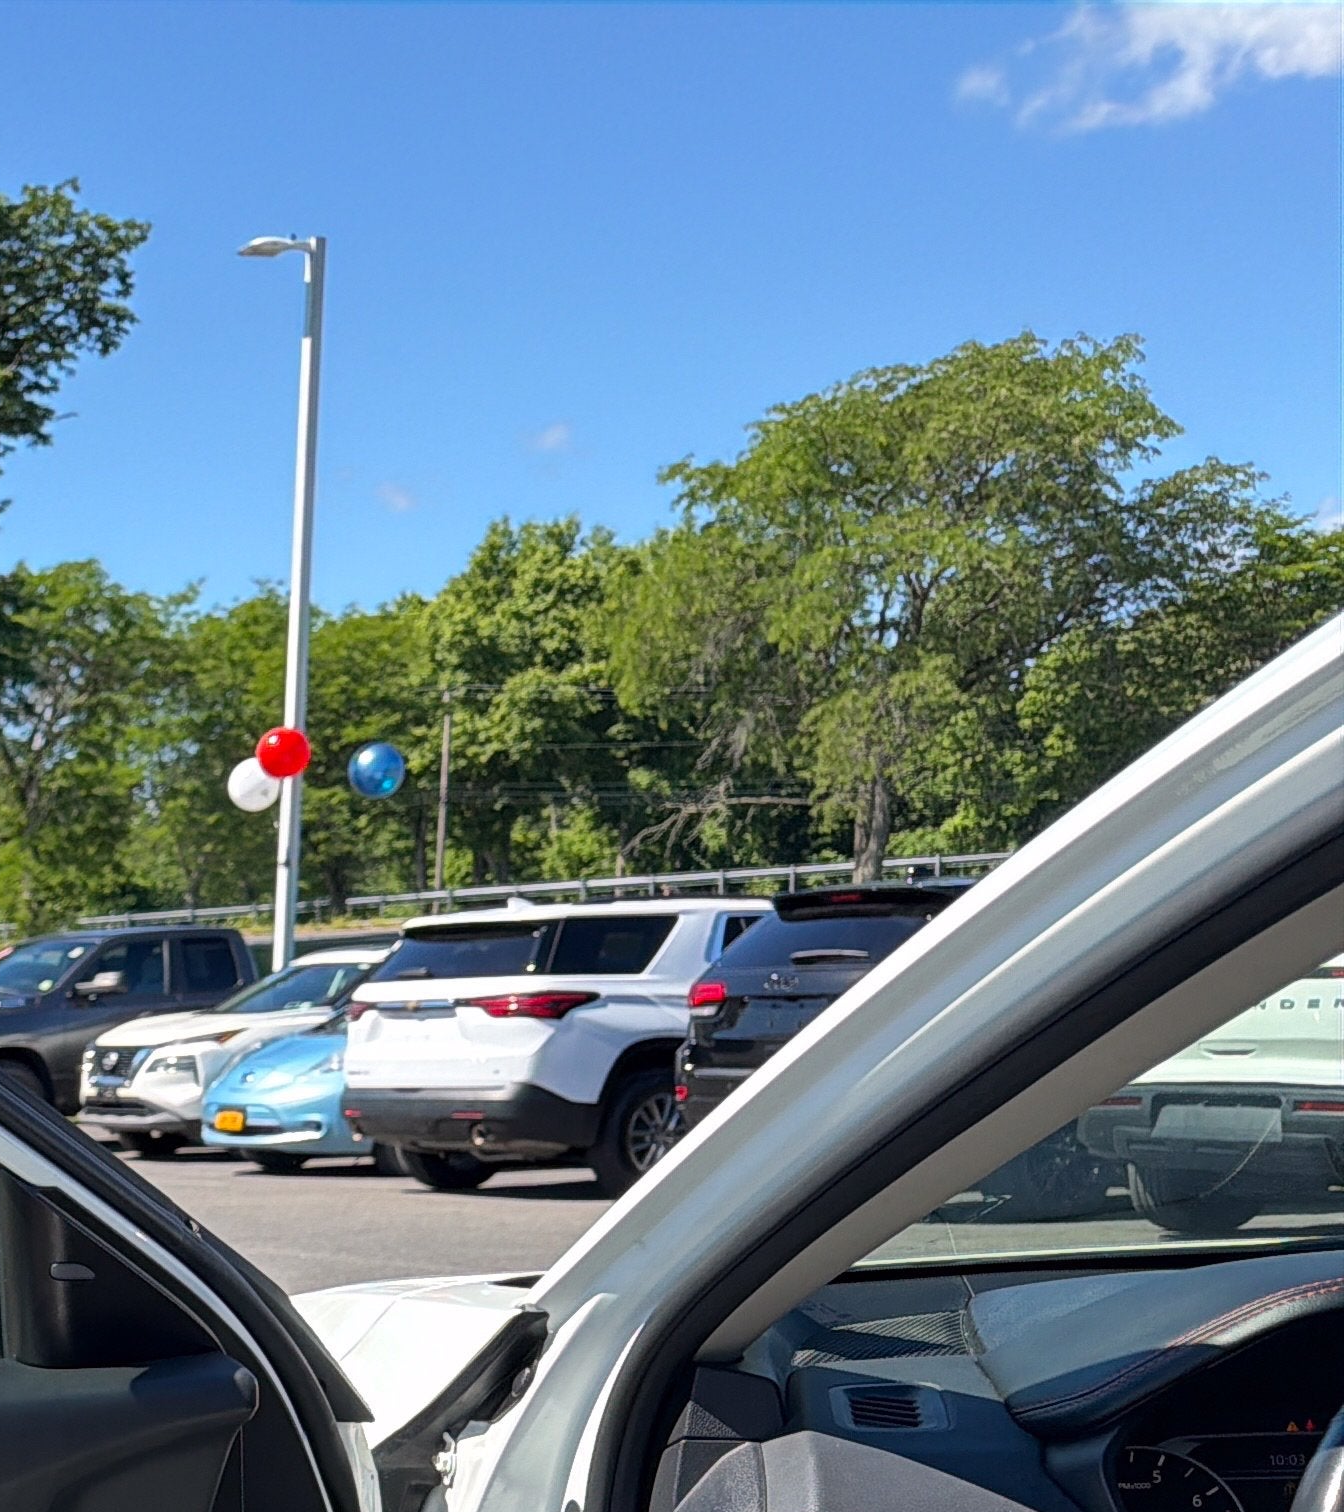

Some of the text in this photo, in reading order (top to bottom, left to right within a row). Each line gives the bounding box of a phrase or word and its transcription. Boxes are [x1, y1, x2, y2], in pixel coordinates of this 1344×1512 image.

[1269, 1454, 1306, 1466] 10:03
[1152, 1470, 1162, 1484] 5
[1192, 1494, 1203, 1508] 6
